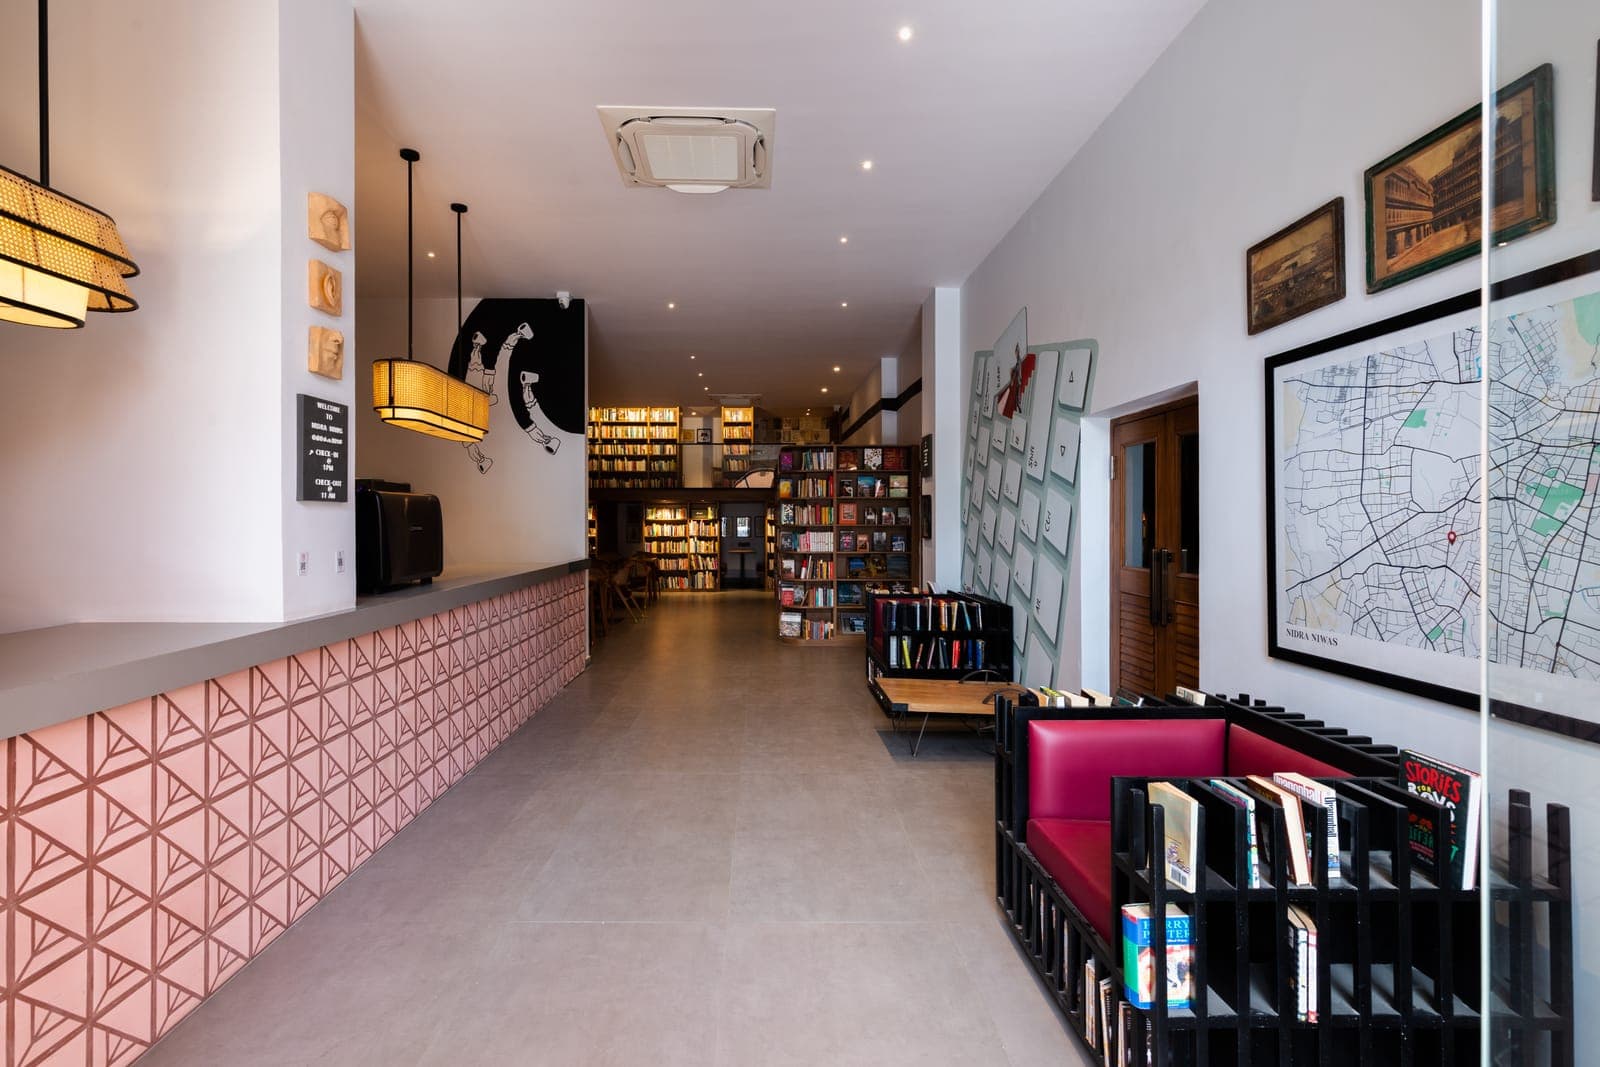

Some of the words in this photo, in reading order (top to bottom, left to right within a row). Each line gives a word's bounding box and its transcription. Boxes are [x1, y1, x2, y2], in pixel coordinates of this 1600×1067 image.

[317, 402, 341, 413] WELCOME
[326, 413, 333, 421] TO
[315, 448, 339, 458] CHECK-IN
[1286, 628, 1309, 640] NIDRA
[1311, 633, 1338, 646] NIWAS
[1417, 784, 1432, 793] FOR
